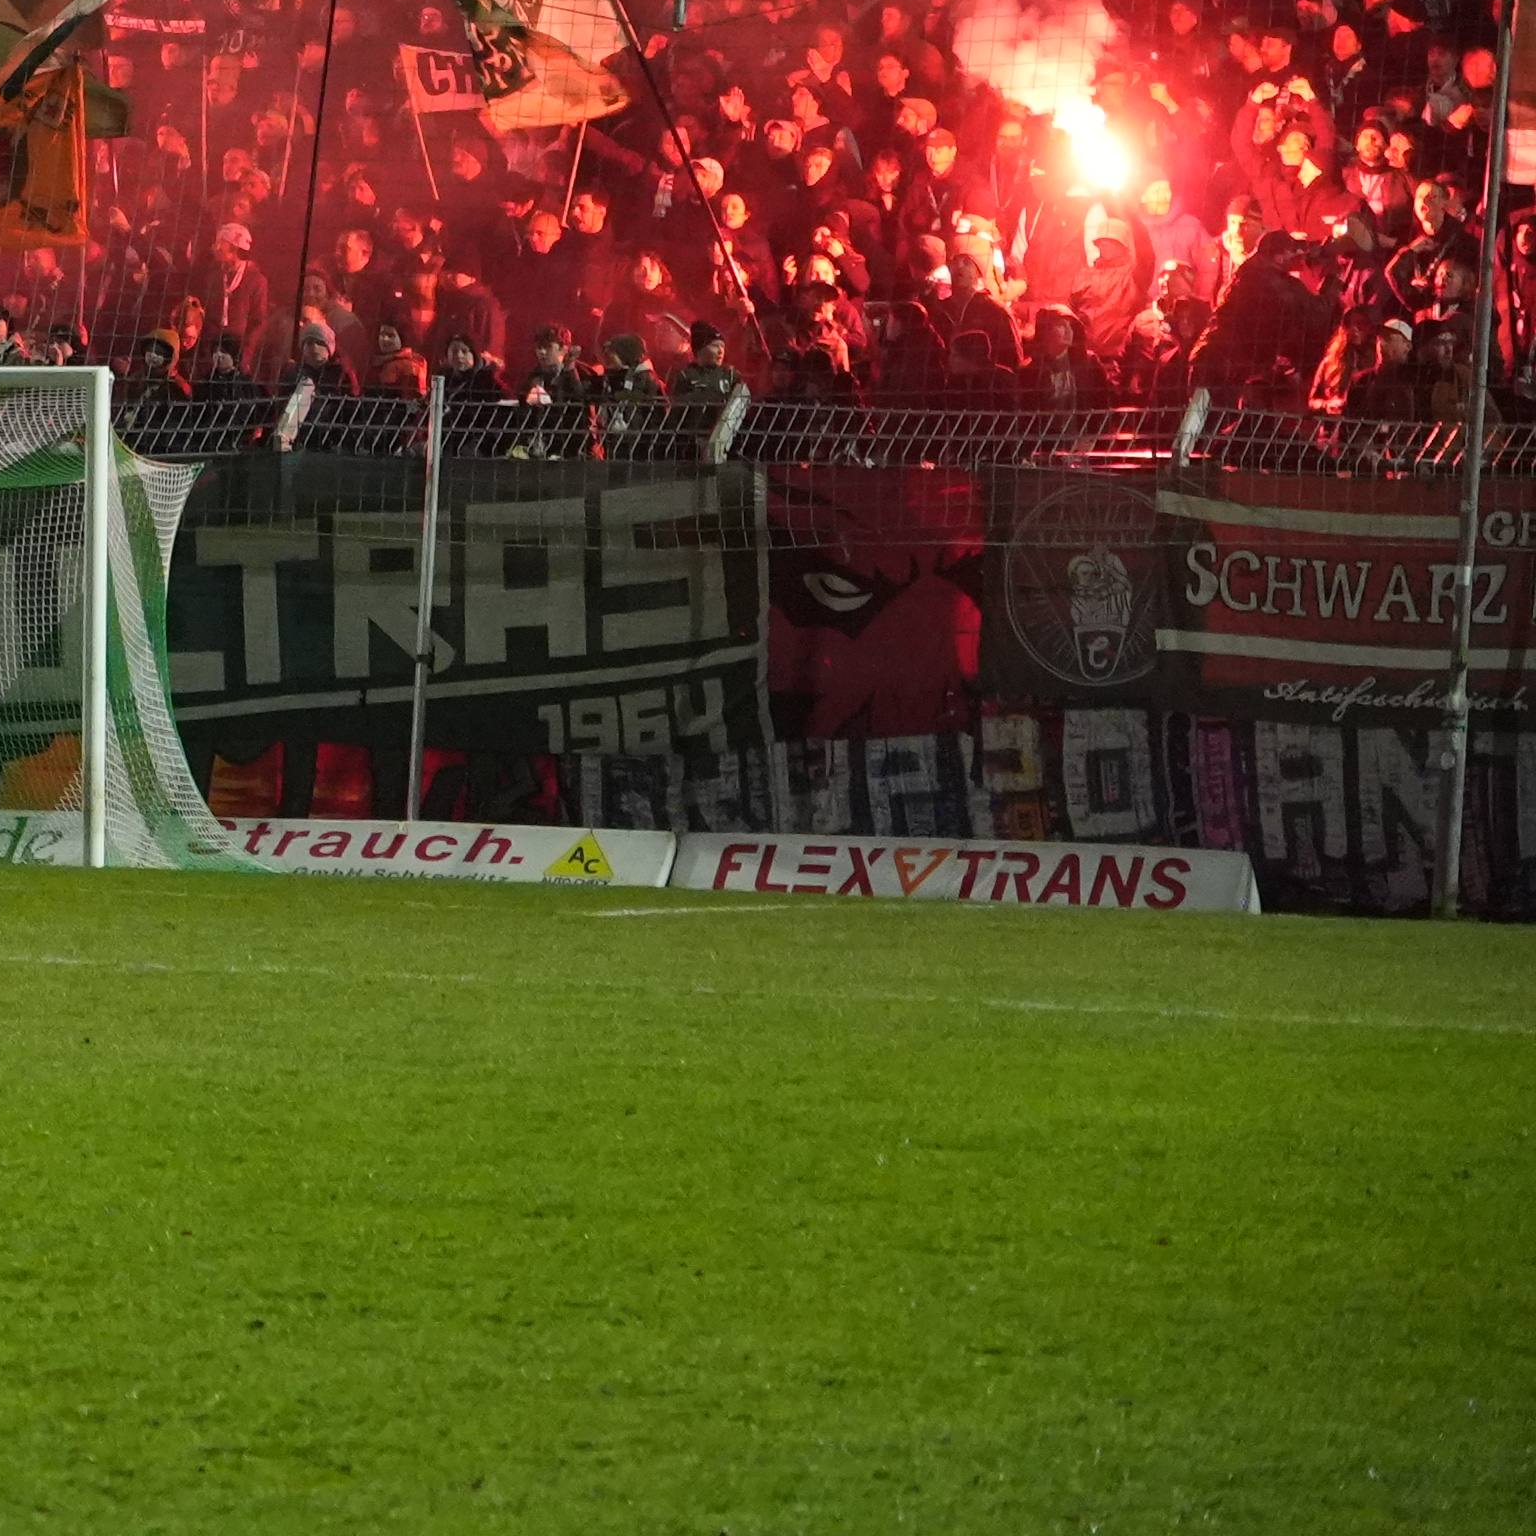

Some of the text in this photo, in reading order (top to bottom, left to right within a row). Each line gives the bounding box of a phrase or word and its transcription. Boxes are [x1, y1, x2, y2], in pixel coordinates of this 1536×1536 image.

[538, 676, 732, 757] 1964
[712, 843, 1192, 910] FLEX TRANS
